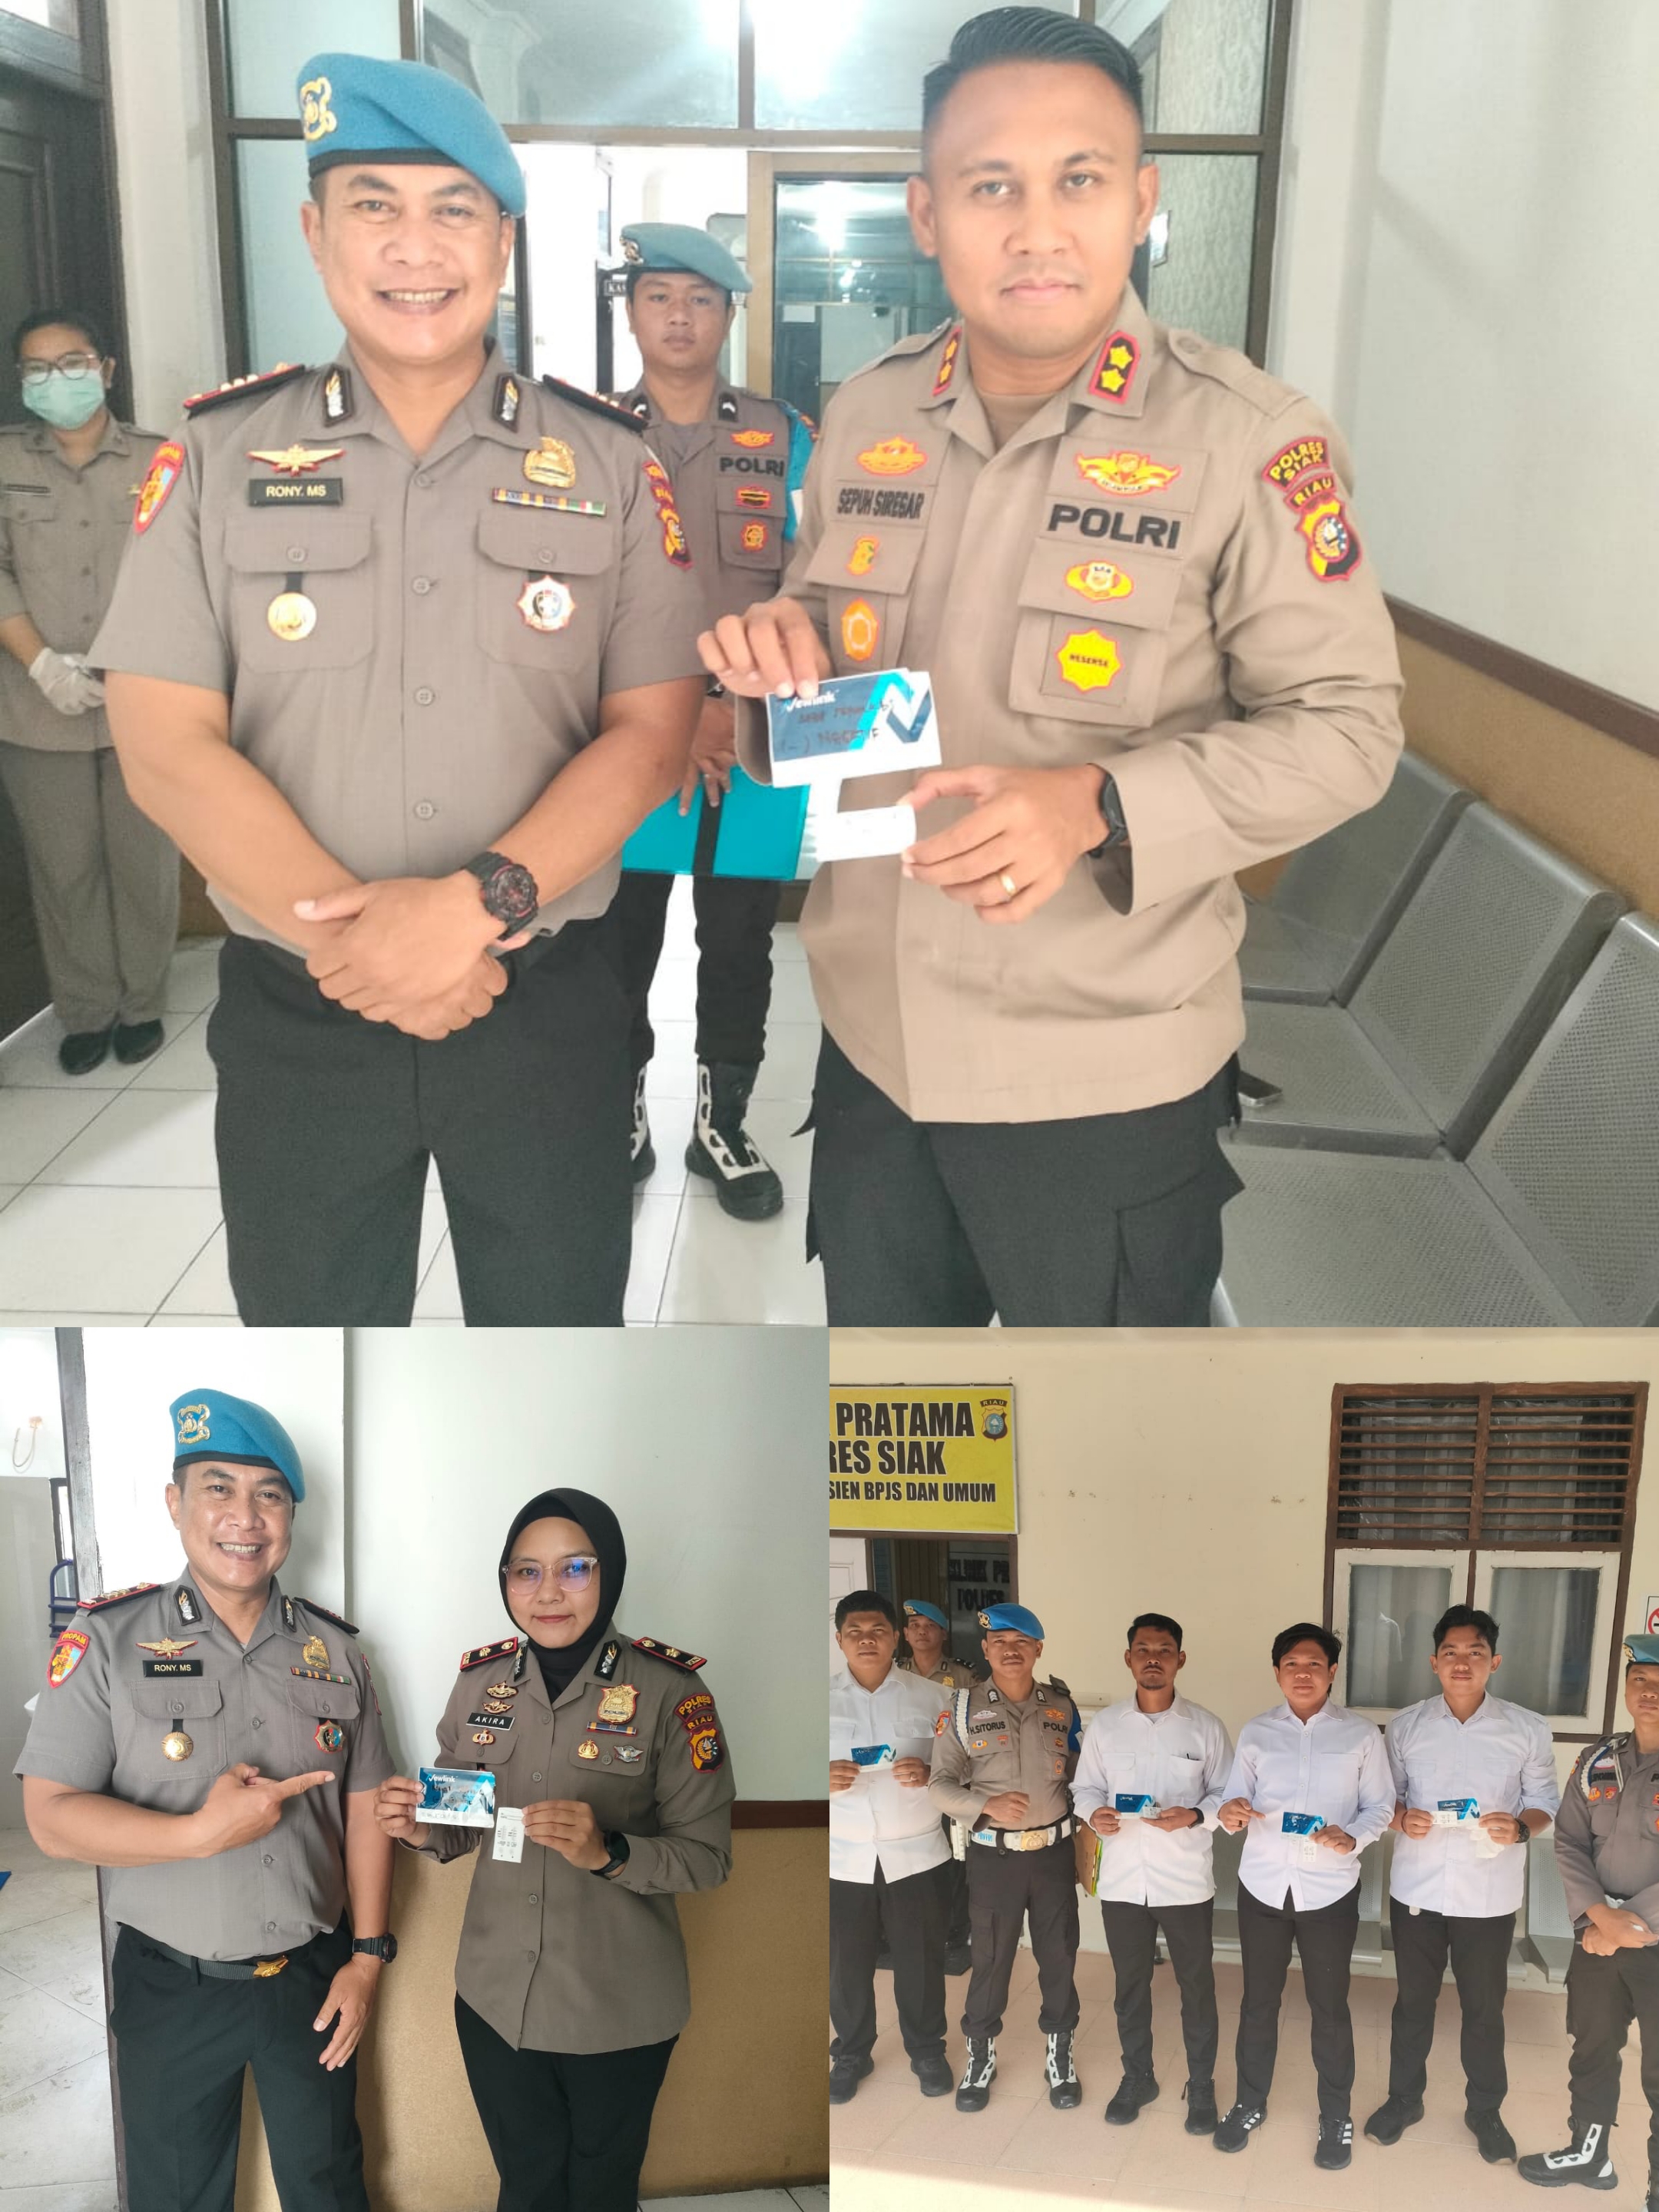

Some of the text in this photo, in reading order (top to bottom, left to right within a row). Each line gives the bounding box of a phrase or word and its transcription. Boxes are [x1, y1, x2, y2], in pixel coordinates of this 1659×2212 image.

[720, 456, 785, 477] POLRI
[1270, 442, 1324, 480] POLRES
[1284, 453, 1323, 482] SIAK
[307, 485, 326, 497] MS
[1293, 477, 1333, 505] RIAU
[1047, 503, 1181, 550] POLRI
[836, 1402, 975, 1436] PRATAMA
[877, 1440, 947, 1475] SIAK
[864, 1482, 902, 1501] BPJS
[906, 1482, 939, 1502] DAN
[942, 1483, 996, 1502] UMUM
[678, 1695, 711, 1715] POLRES
[475, 1716, 505, 1726] AKIRA
[687, 1715, 713, 1730] RIAU
[426, 1773, 455, 1782] Newlink
